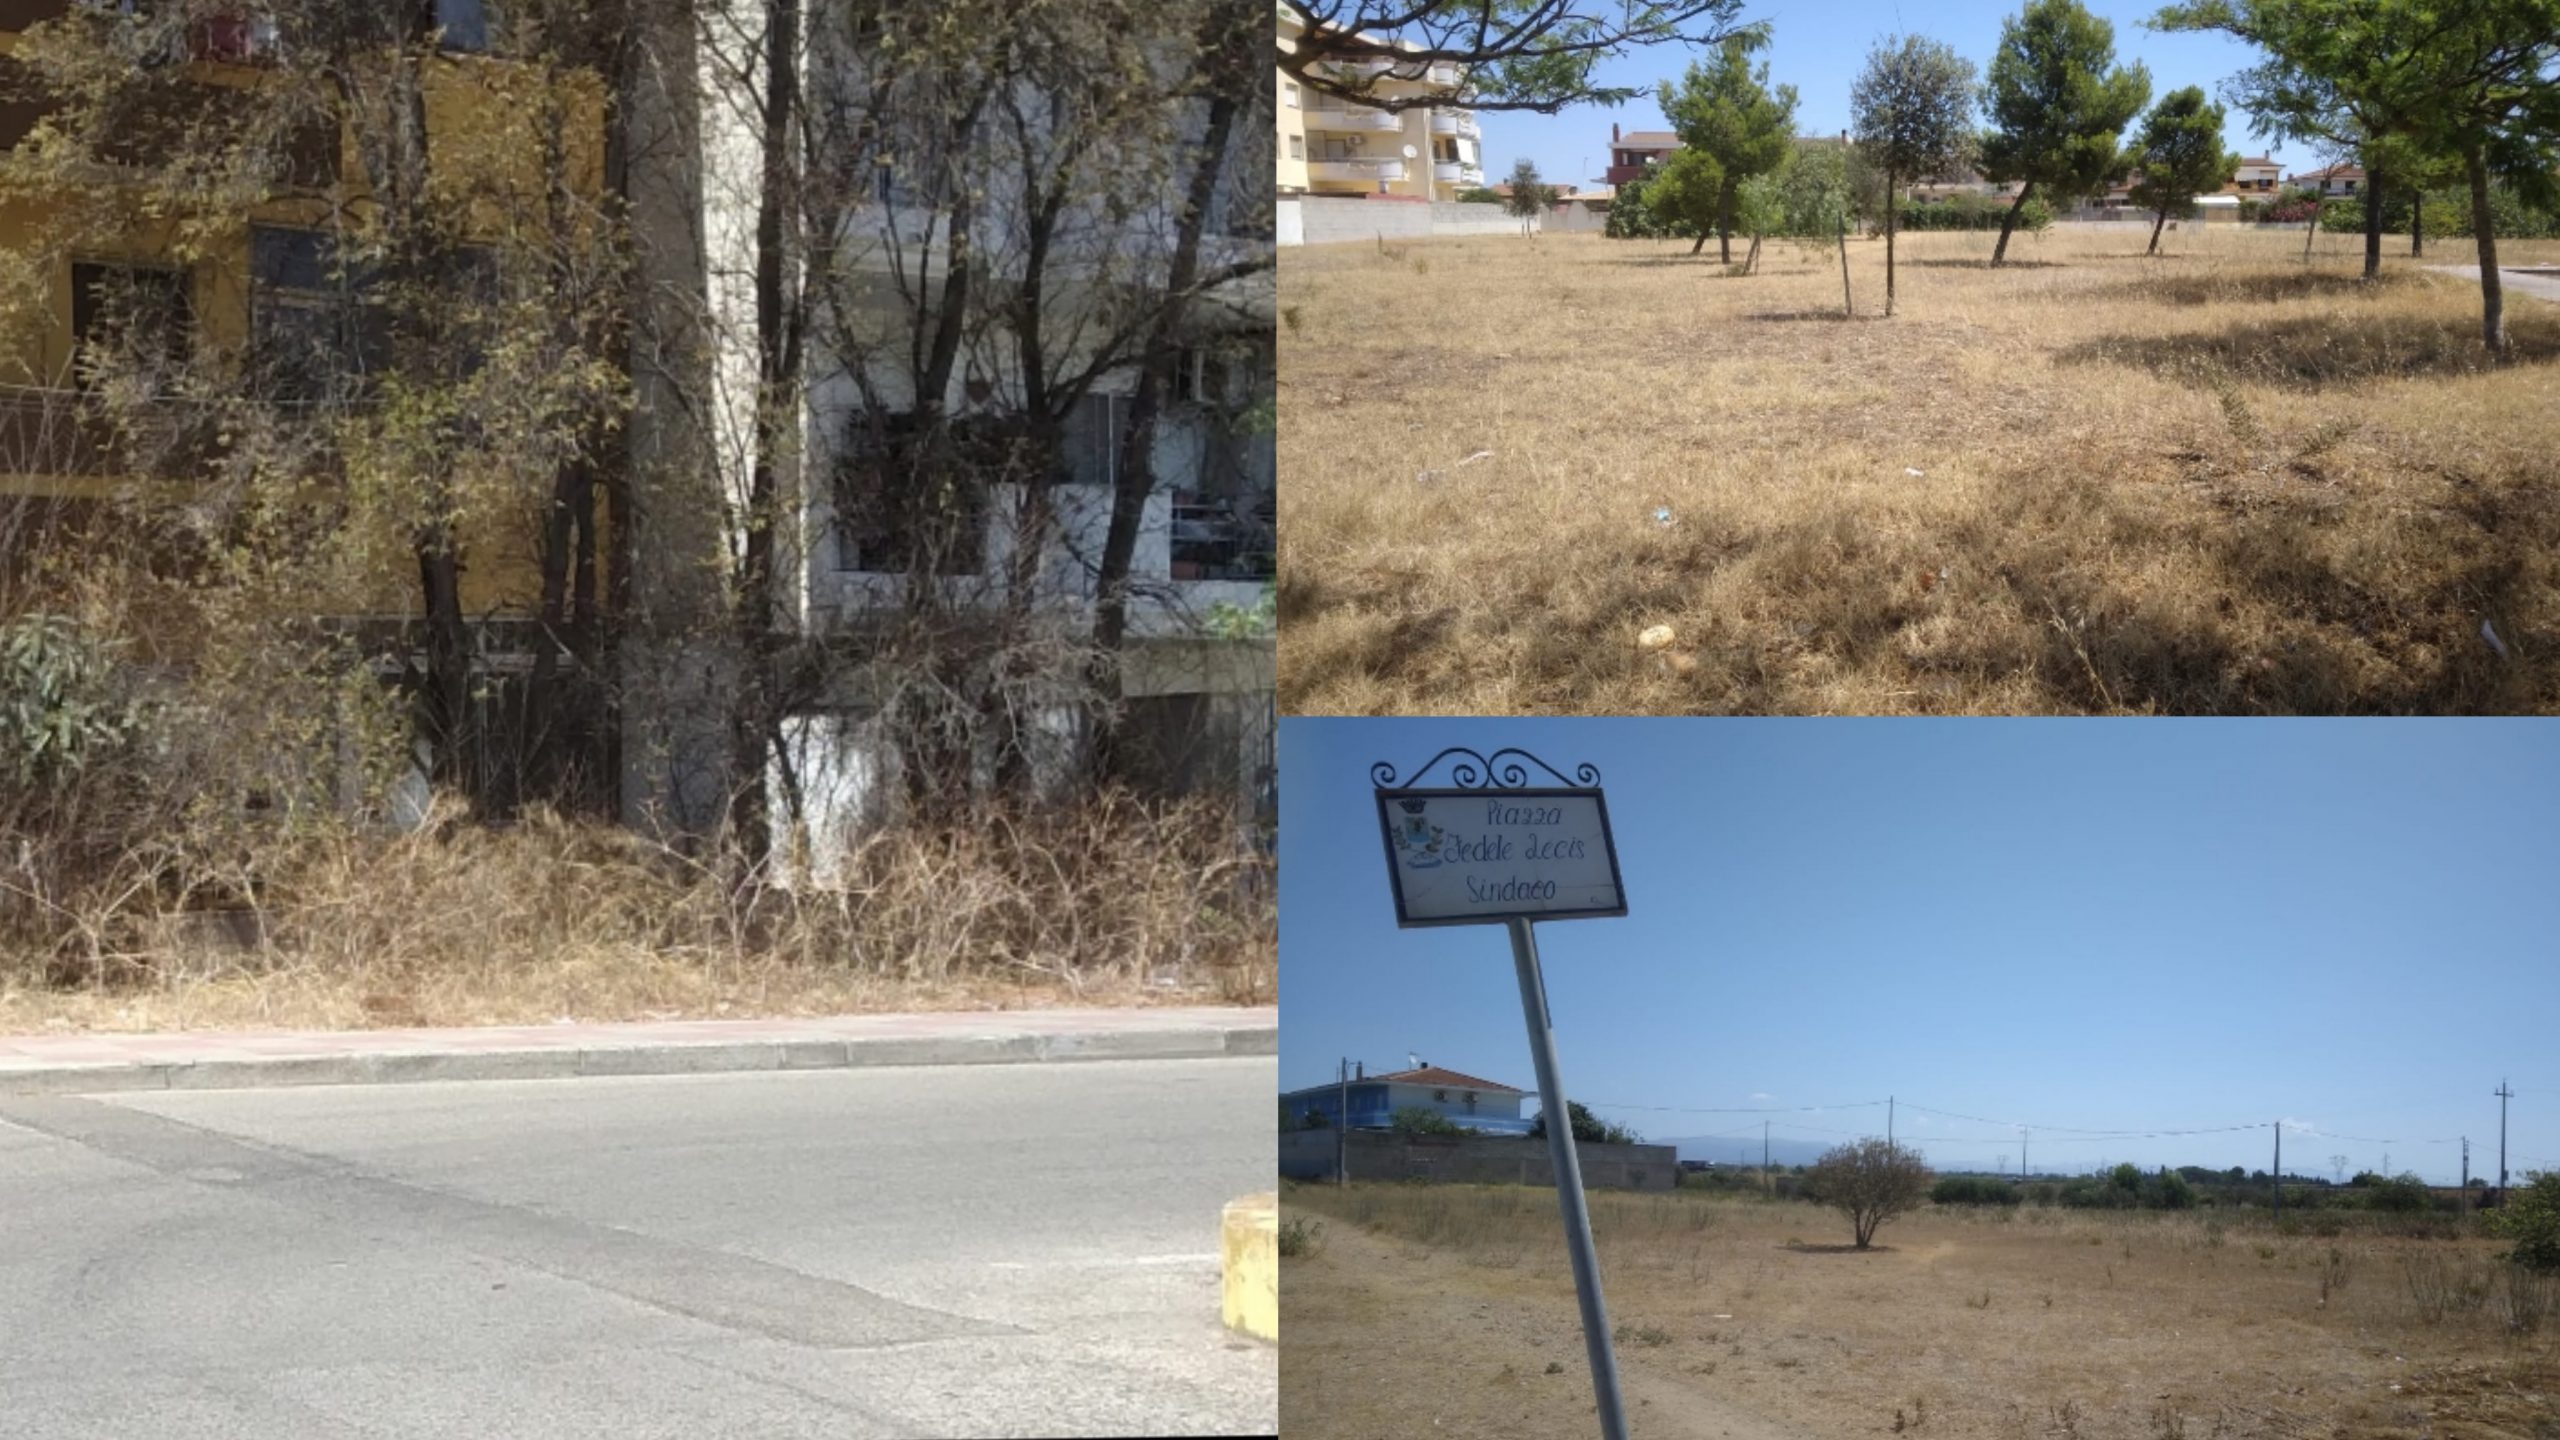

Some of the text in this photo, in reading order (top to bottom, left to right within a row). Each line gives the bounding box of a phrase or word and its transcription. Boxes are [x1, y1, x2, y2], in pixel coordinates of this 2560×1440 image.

[1487, 799, 1562, 825] Piazza
[1443, 833, 1513, 864] Fedele
[1466, 875, 1556, 903] Sindaco
